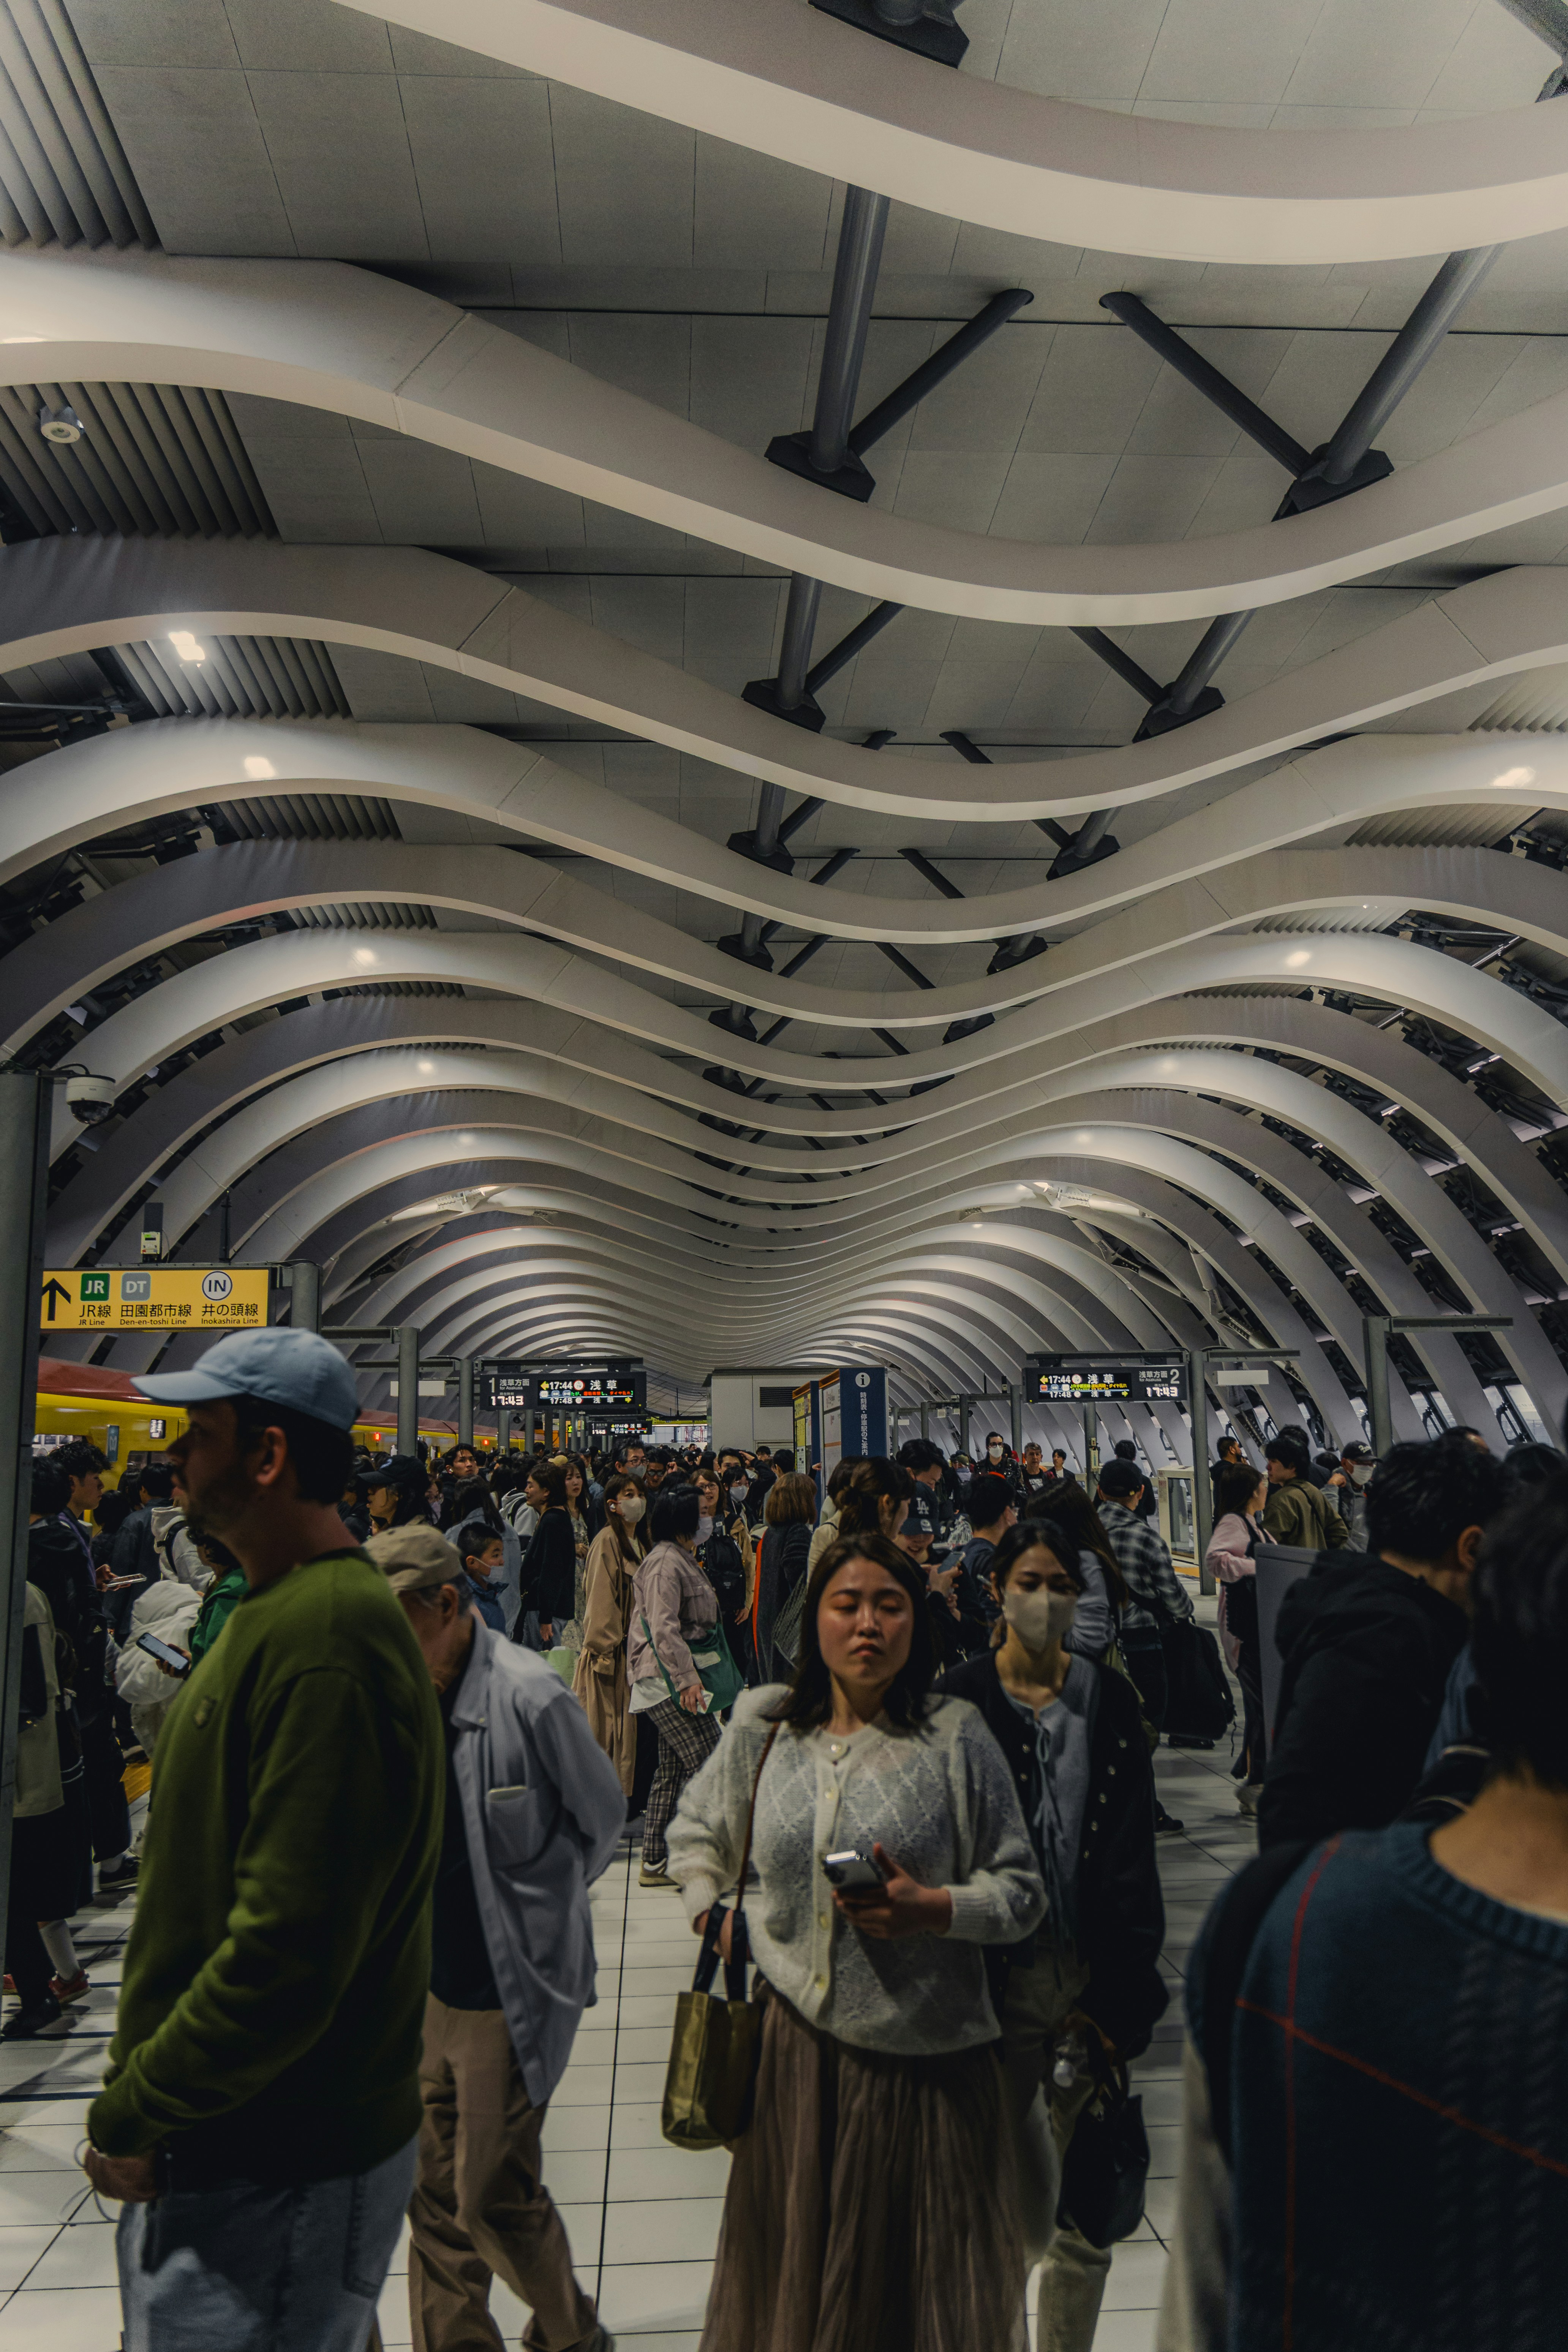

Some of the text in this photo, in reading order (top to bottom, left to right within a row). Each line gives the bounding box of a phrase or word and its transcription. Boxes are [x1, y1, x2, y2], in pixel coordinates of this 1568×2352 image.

[85, 1280, 104, 1294] JR
[126, 1280, 147, 1294] DT
[208, 1280, 226, 1292] IN
[79, 1304, 111, 1318] JR線
[120, 1304, 191, 1317] 田園都市線
[201, 1303, 258, 1317] 井の頭線
[1048, 1375, 1071, 1384] 17:44
[1170, 1369, 1180, 1384] 2
[488, 1377, 495, 1393] 1
[549, 1381, 573, 1390] 17:44
[1146, 1386, 1178, 1397] 17:43
[490, 1396, 524, 1405] 17:43
[916, 1497, 929, 1515] LA
